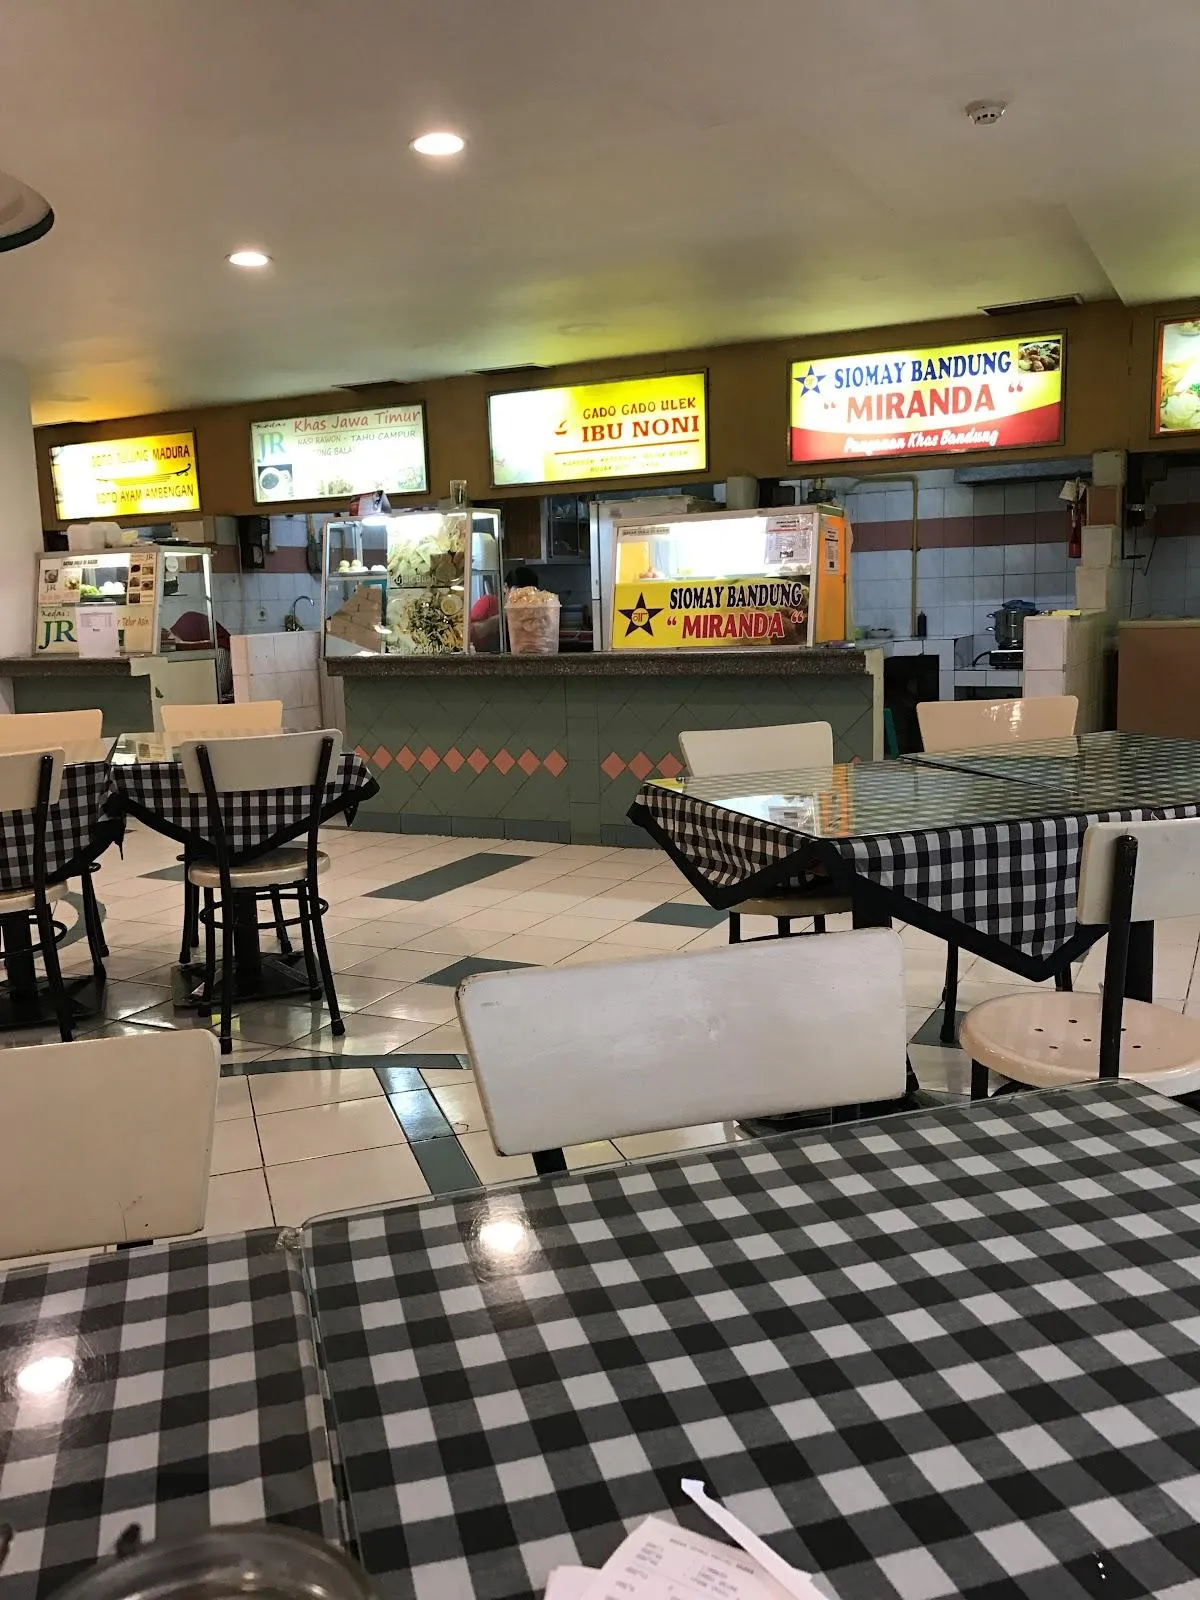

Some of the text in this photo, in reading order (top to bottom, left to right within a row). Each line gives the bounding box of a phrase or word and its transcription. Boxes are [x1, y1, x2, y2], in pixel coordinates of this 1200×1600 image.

[834, 350, 1012, 389] SIOMAY BANDUNG
[583, 396, 696, 420] GADO GADO ULEK
[846, 383, 996, 424] MIRANDA
[293, 409, 421, 434] Khas Jawa Timur
[582, 415, 700, 443] IBU NONI
[256, 431, 286, 464] JR
[351, 433, 376, 443] TAHU
[377, 430, 417, 441] CAMPUR
[907, 432, 938, 450] Khas
[939, 427, 999, 447] Bandung
[152, 444, 191, 461] MADURA
[120, 489, 143, 504] AYAM
[144, 484, 195, 499] AMBENGAN
[669, 583, 803, 610] SIOMAY BANDUNG
[38, 620, 78, 650] JR
[682, 611, 785, 639] MIRANDA
